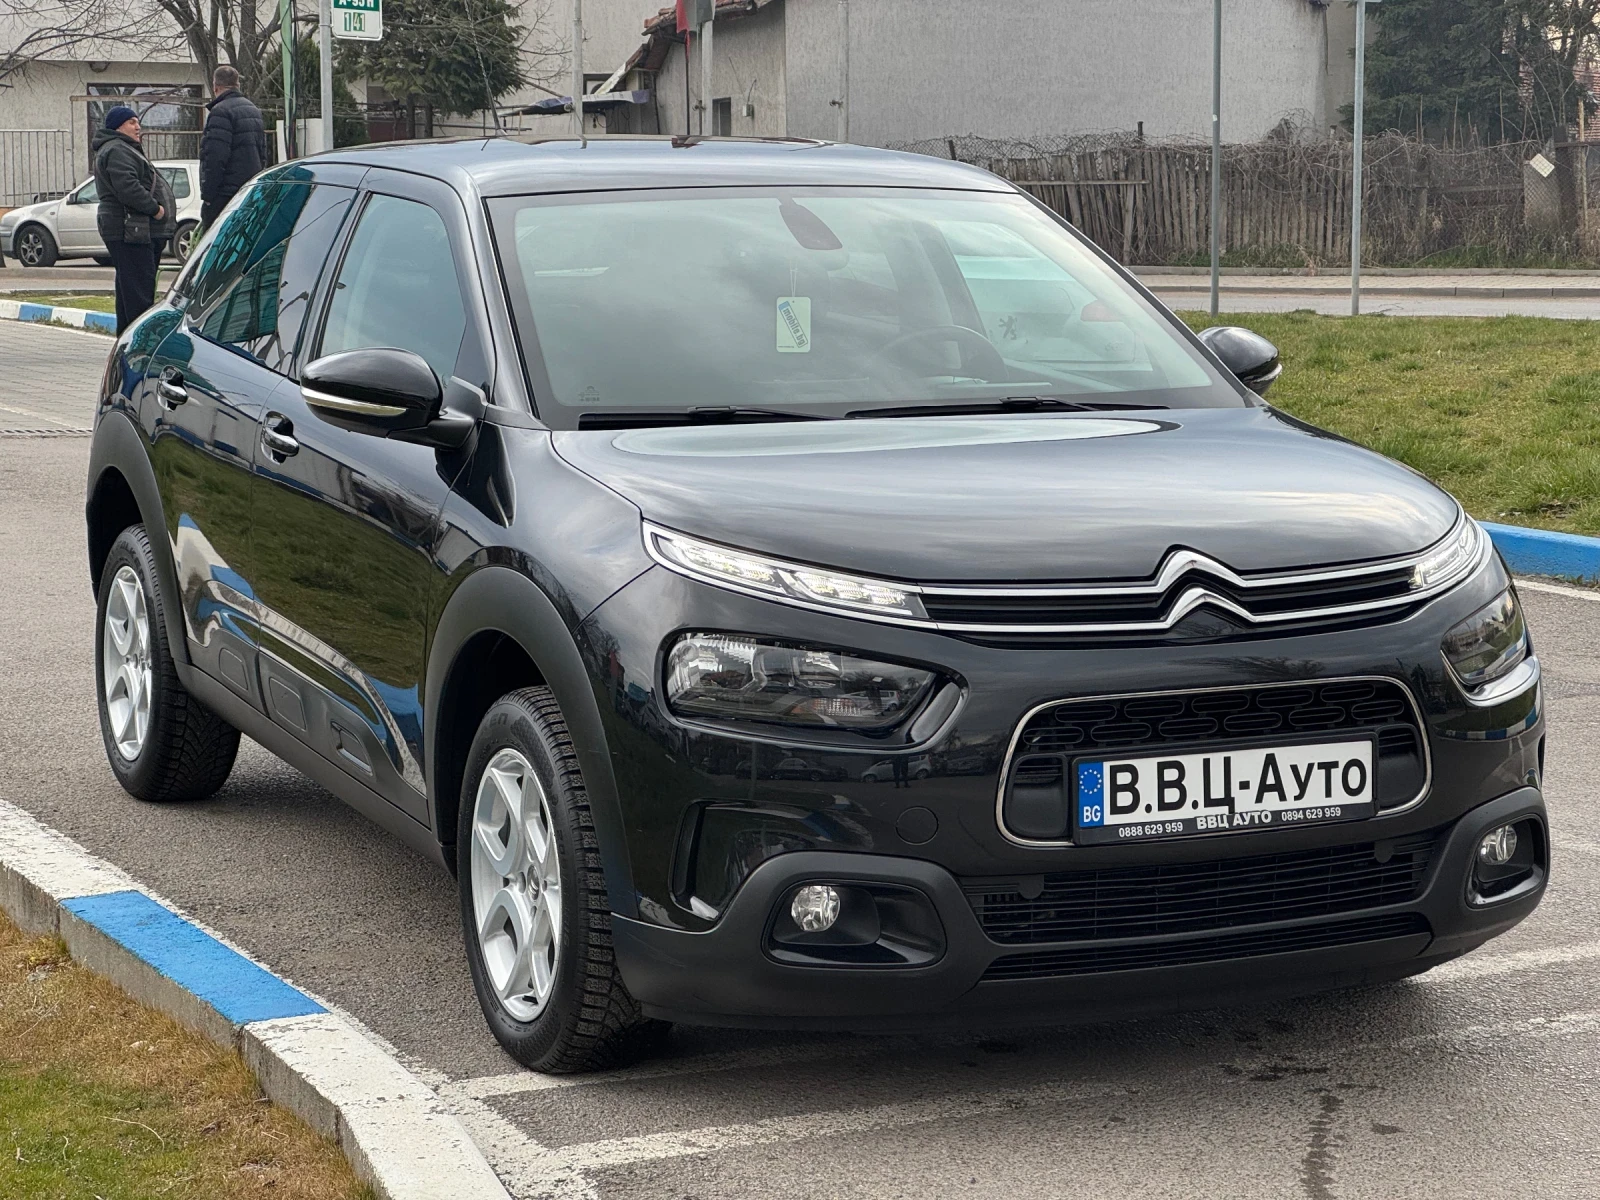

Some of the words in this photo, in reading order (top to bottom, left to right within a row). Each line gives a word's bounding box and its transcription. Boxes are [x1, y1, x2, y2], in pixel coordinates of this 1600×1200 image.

[782, 308, 806, 346] mobile.bg
[1083, 806, 1101, 823] BG
[1196, 814, 1229, 830] ВВЦ
[1232, 810, 1272, 827] АУТО
[1281, 810, 1304, 822] 0894
[1305, 808, 1323, 820] 629
[1324, 807, 1341, 819] 959
[1119, 826, 1143, 838] 0888
[1145, 824, 1163, 835] 629
[1165, 822, 1183, 834] 959
